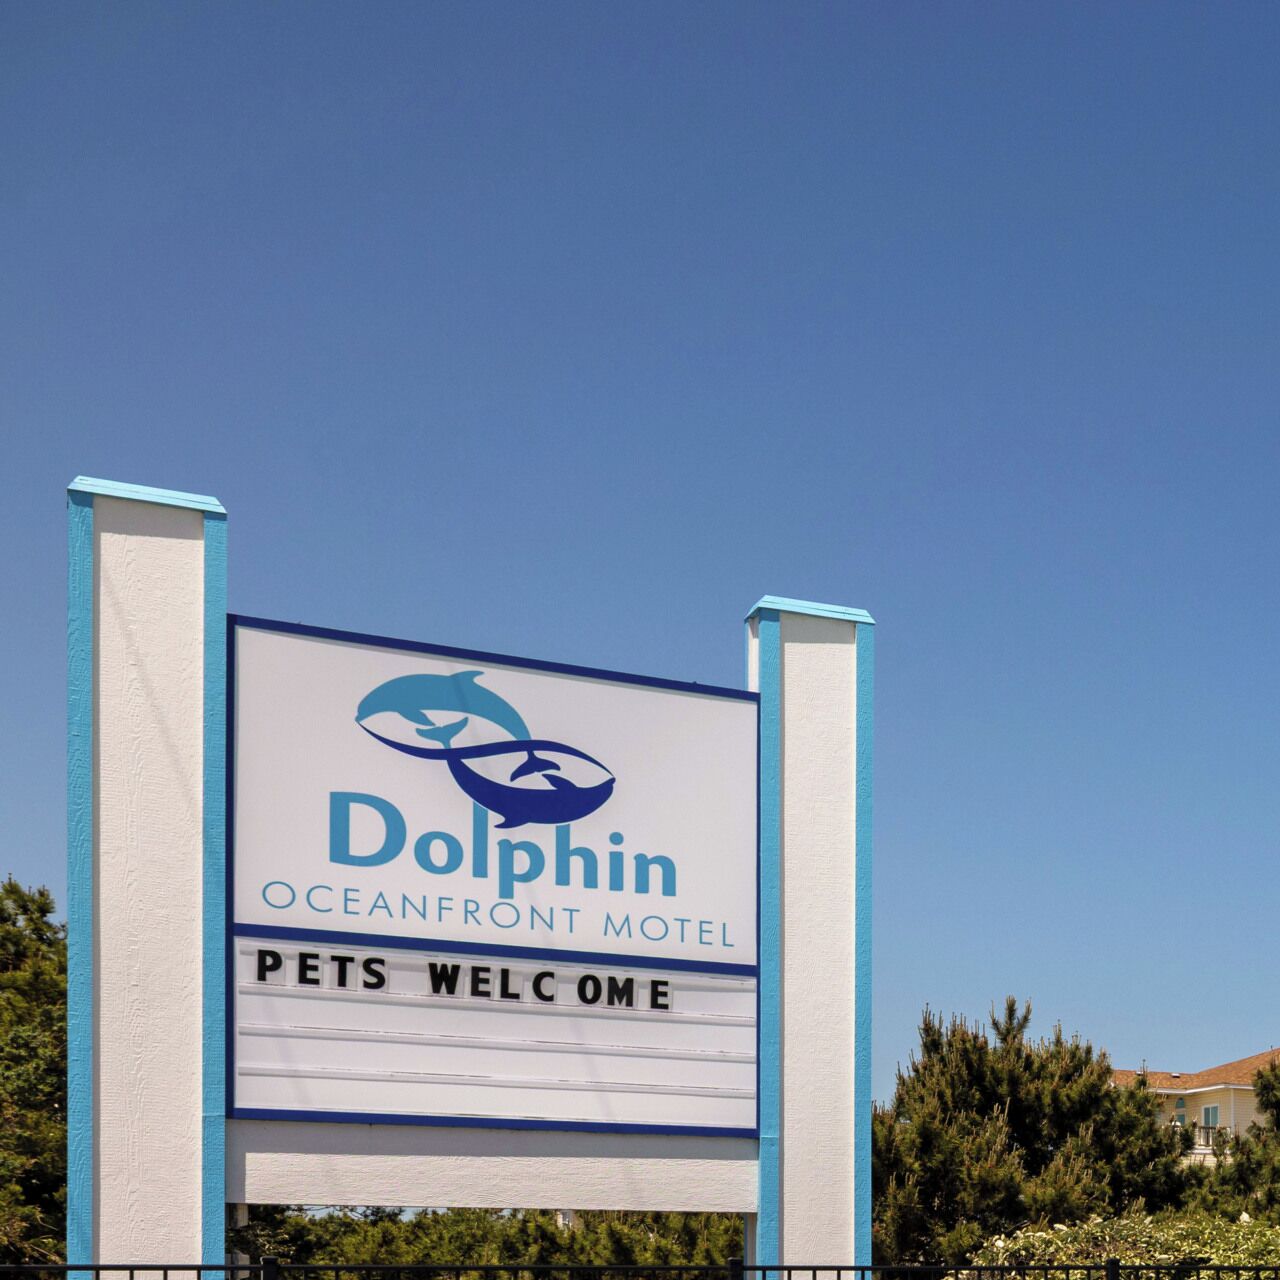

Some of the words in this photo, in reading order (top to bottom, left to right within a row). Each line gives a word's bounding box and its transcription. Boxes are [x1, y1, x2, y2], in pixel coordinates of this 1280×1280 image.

[328, 791, 677, 899] Dolphin
[262, 881, 581, 935] OCEANFRONT
[603, 912, 735, 947] MOTEL
[256, 950, 387, 990] PETS
[428, 962, 670, 1010] WELCOME
